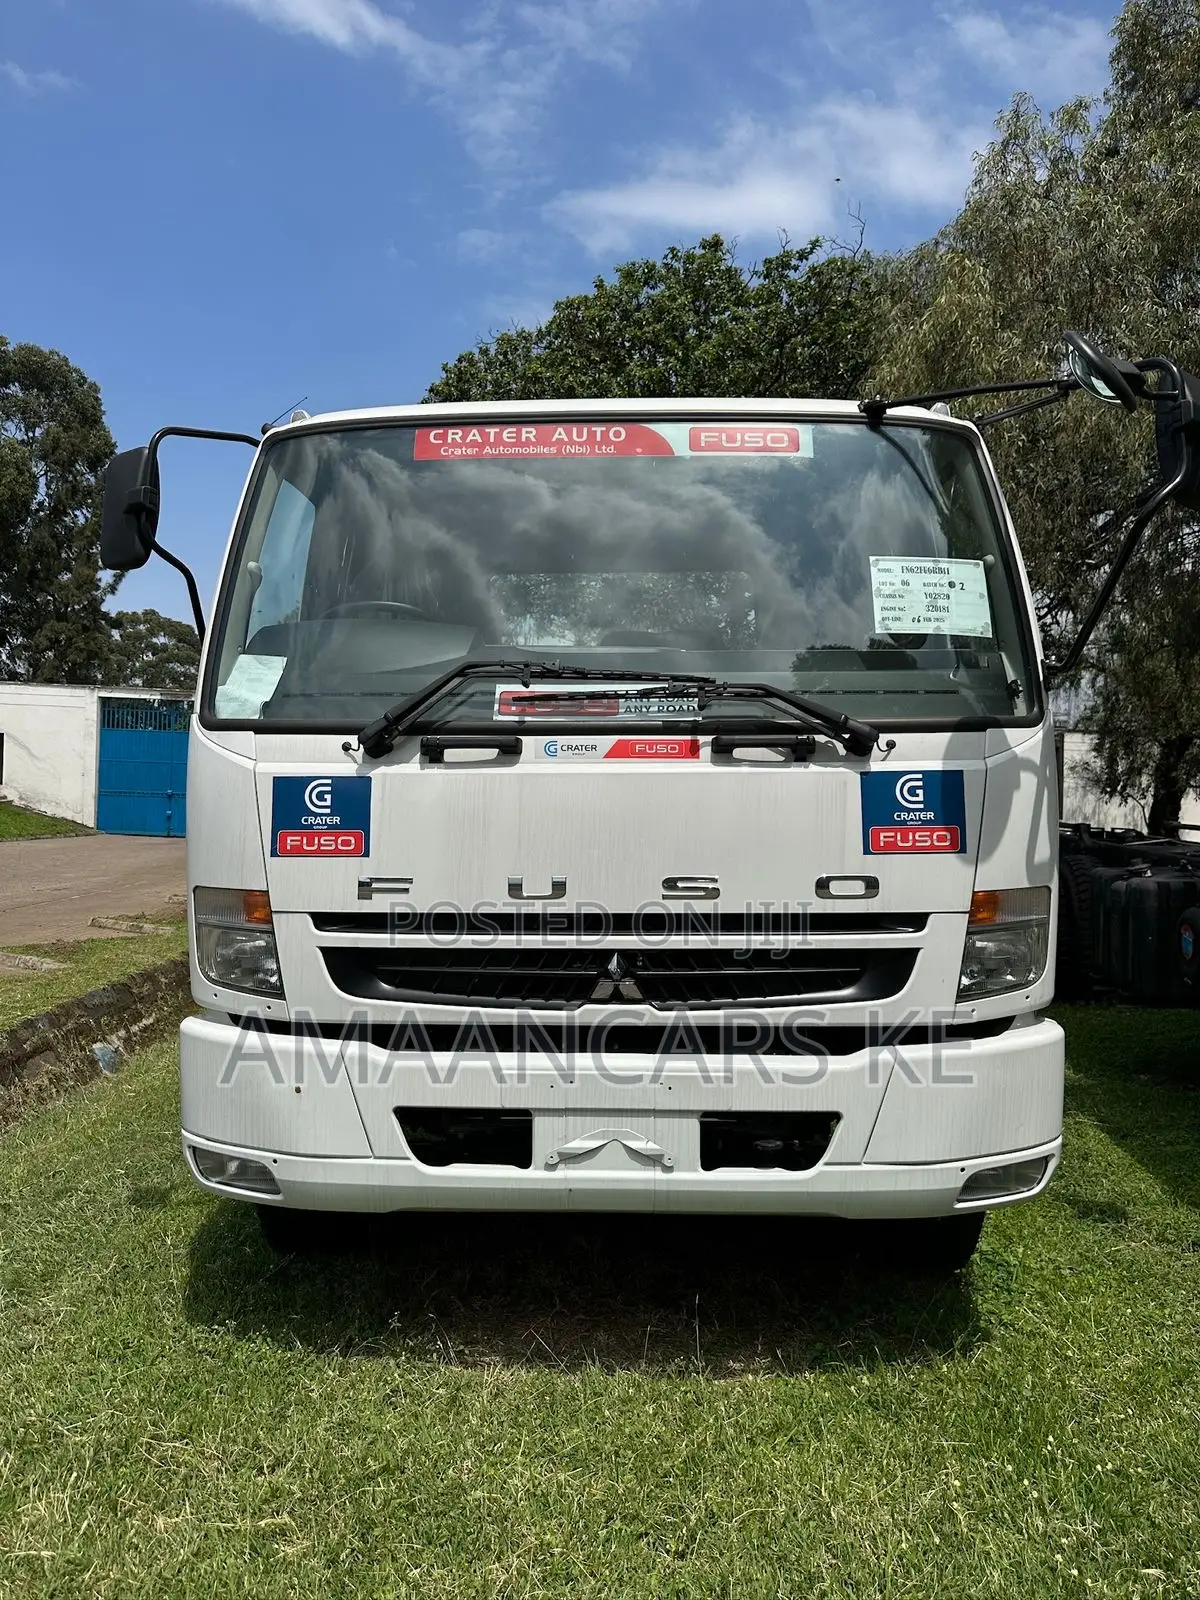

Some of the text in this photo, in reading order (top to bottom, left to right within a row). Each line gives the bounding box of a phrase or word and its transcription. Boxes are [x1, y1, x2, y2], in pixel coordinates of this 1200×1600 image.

[429, 426, 627, 445] CRATER AUTO
[699, 431, 790, 448] FUSO
[440, 446, 479, 456] Crater
[483, 444, 557, 455] Automobiles
[595, 444, 617, 454] Ltd.
[623, 704, 695, 713] ANY ROAD
[560, 744, 598, 752] CRATER
[635, 744, 679, 753] FUSO
[301, 816, 341, 825] CRATER
[893, 811, 935, 820] CRATER
[286, 836, 356, 851] FUSO
[879, 831, 951, 847] FUSO
[357, 874, 880, 900] FUSO
